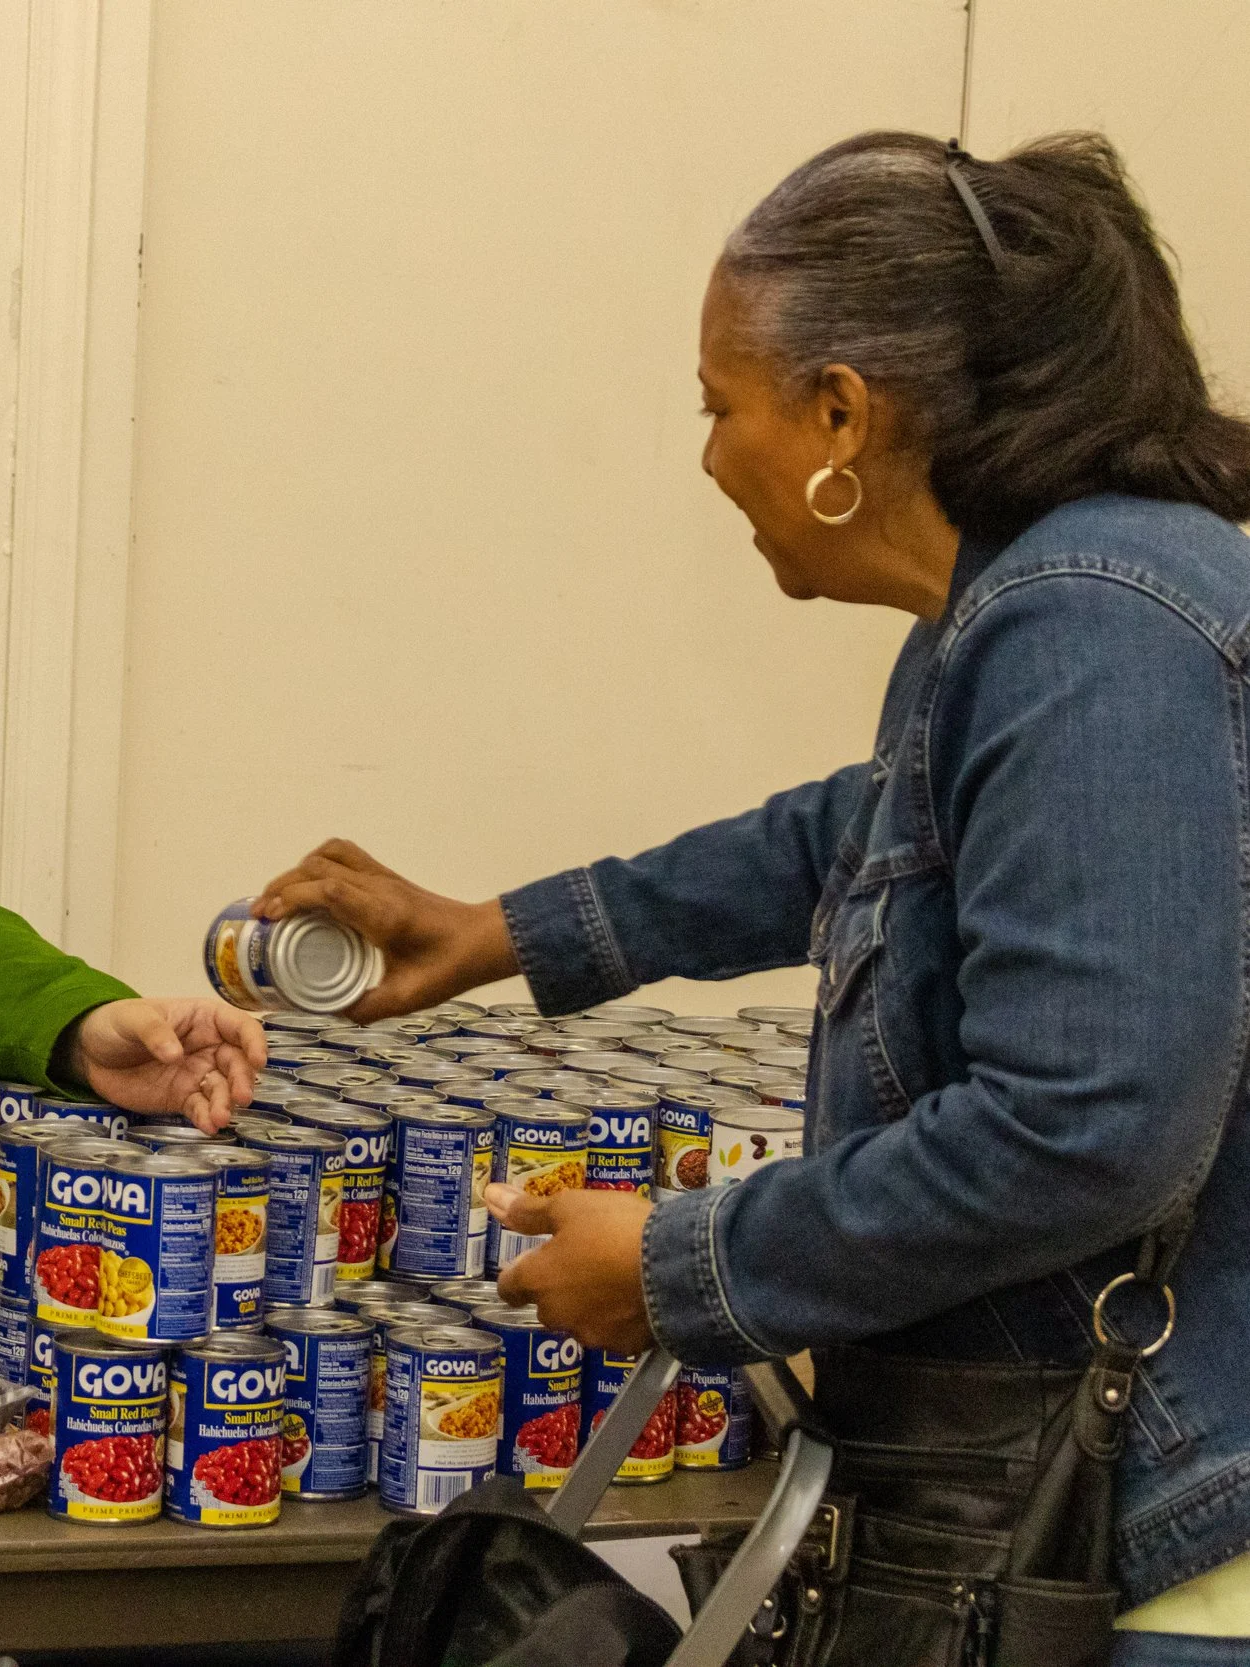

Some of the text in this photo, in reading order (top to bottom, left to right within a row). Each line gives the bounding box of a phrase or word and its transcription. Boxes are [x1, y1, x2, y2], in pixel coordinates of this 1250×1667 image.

[659, 1107, 696, 1128] GOYA
[514, 1127, 562, 1144] GOYA
[588, 1116, 650, 1143] OYA
[598, 1155, 641, 1167] Red Beans
[448, 1164, 462, 1175] 120
[593, 1166, 630, 1180] Coloradas
[293, 1189, 308, 1200] 120
[59, 1213, 86, 1229] Small
[107, 1223, 128, 1237] Peas
[233, 1287, 261, 1301] GOYA
[50, 1310, 79, 1322] PRIME
[426, 1359, 477, 1376] GOYA
[78, 1361, 167, 1397] GOYA
[547, 1378, 568, 1392] Small
[692, 1372, 729, 1387] Pequeñas
[396, 1388, 409, 1400] 120
[522, 1392, 567, 1406] Habichuelas
[284, 1397, 312, 1410] queñas
[90, 1406, 161, 1419] Small Red Beans
[224, 1410, 271, 1425] Small Red
[67, 1416, 152, 1434] Habichuelas Coloradas
[198, 1424, 248, 1438] Habichuelas
[83, 1505, 114, 1515] PRIME
[218, 1510, 250, 1520] PRIME
